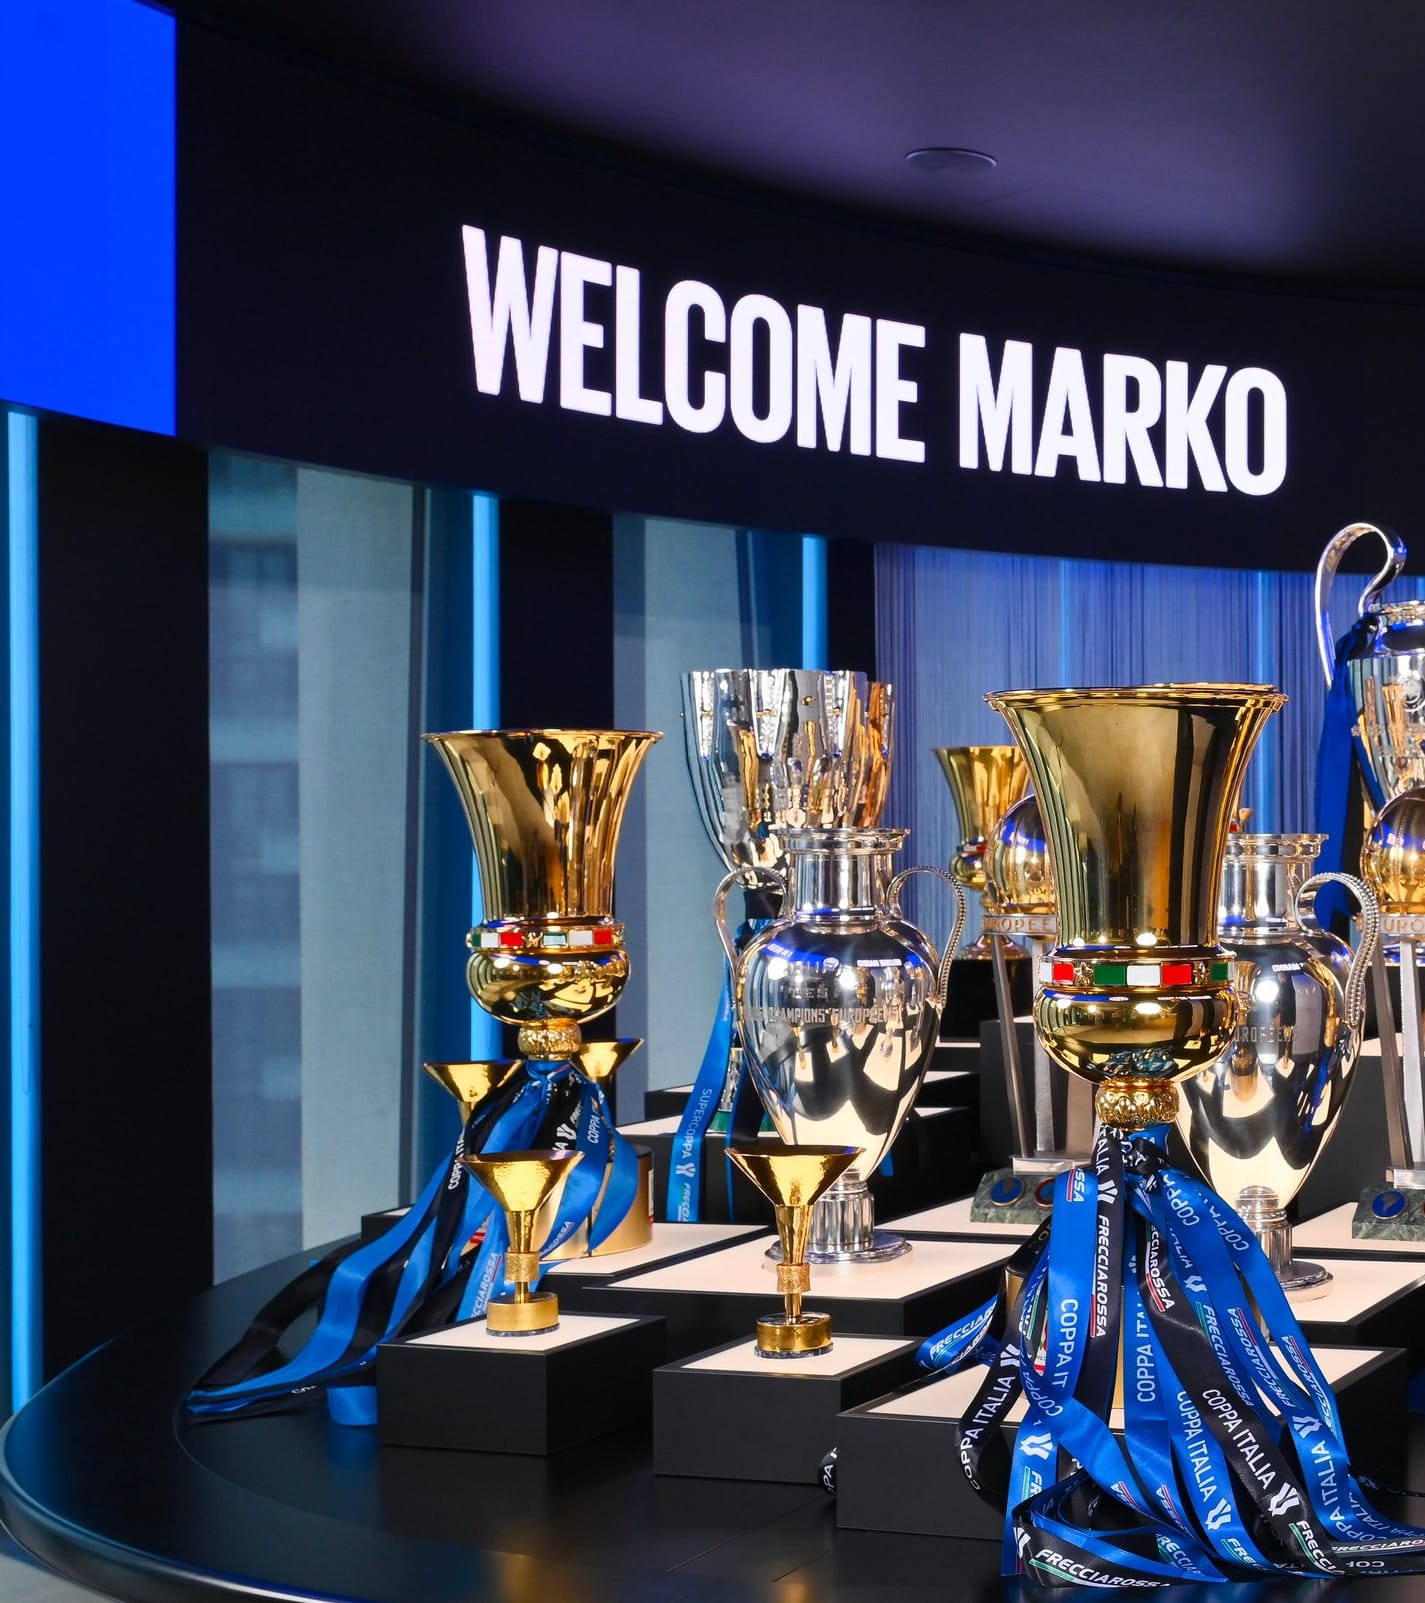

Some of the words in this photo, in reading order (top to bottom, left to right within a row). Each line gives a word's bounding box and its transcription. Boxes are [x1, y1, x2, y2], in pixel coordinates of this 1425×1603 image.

[461, 224, 926, 464] WELCOME
[958, 332, 1288, 496] MARKO
[586, 1114, 602, 1144] COPPA
[681, 1088, 713, 1160] SUPERCOPPA
[1095, 1214, 1110, 1338] FRECCIAROSSA
[1057, 1298, 1079, 1368] COPPA
[1137, 1344, 1156, 1403] COPPA
[1203, 1304, 1255, 1407] FRECCIAROSSA
[1227, 1307, 1297, 1409] FRECCIAROSSA
[960, 1427, 984, 1491] COPPA
[973, 1375, 1016, 1425] ITALIA
[1187, 1439, 1218, 1503] ITALIA
[1202, 1388, 1243, 1434] COPPA
[1236, 1428, 1277, 1490] ITALIA
[1311, 1439, 1337, 1506] ITALIA
